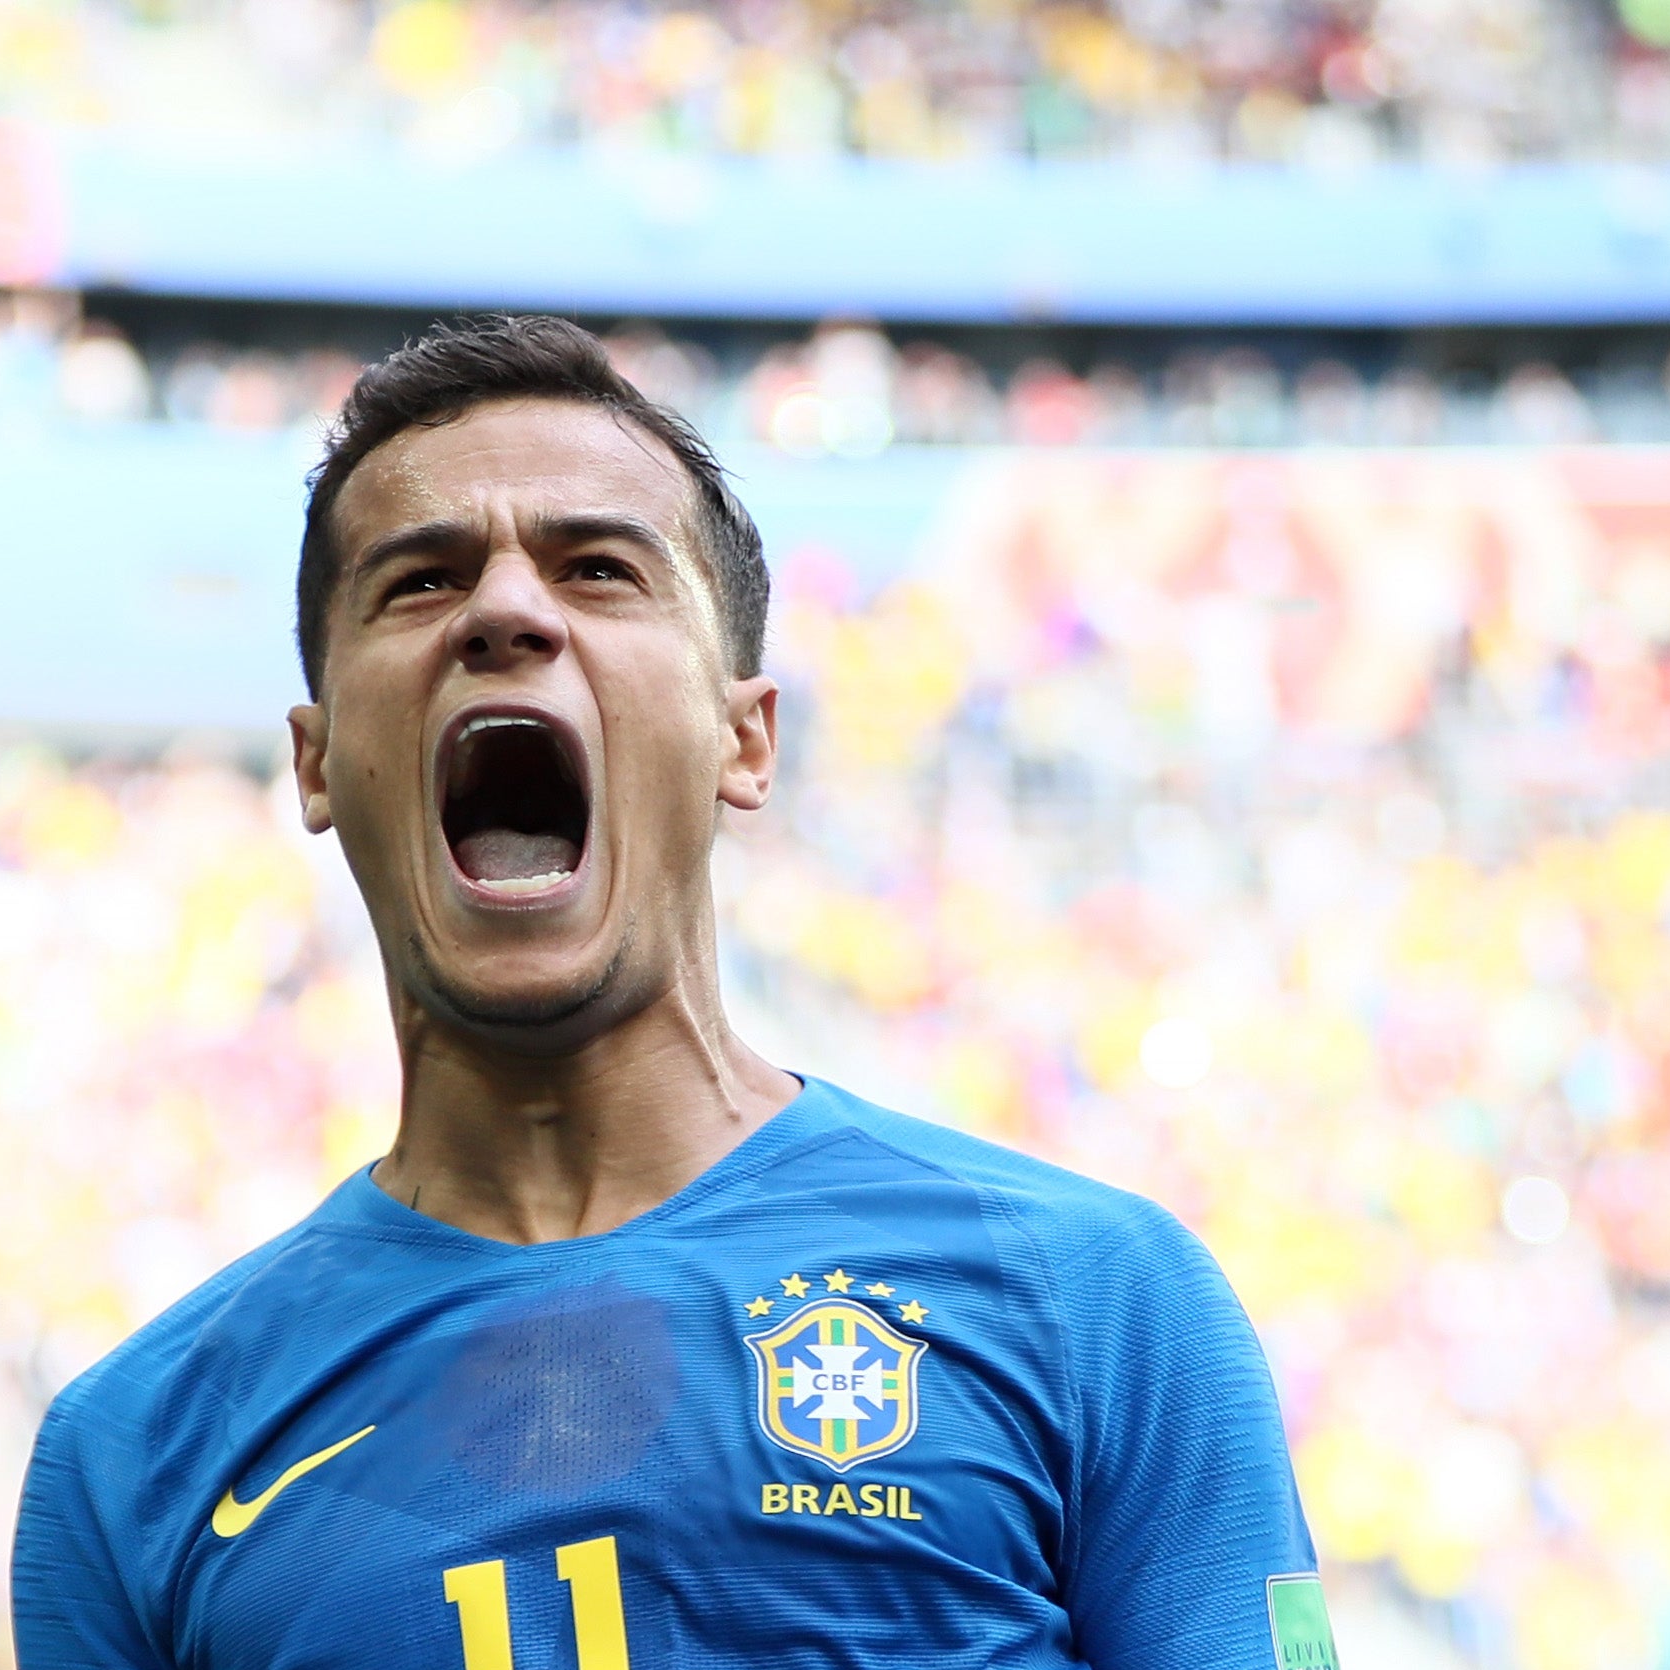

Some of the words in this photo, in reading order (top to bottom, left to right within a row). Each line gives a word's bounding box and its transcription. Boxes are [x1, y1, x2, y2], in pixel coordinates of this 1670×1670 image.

[812, 1374, 865, 1391] CBF
[761, 1482, 923, 1521] BRASIL
[1283, 1640, 1337, 1663] LIVI
